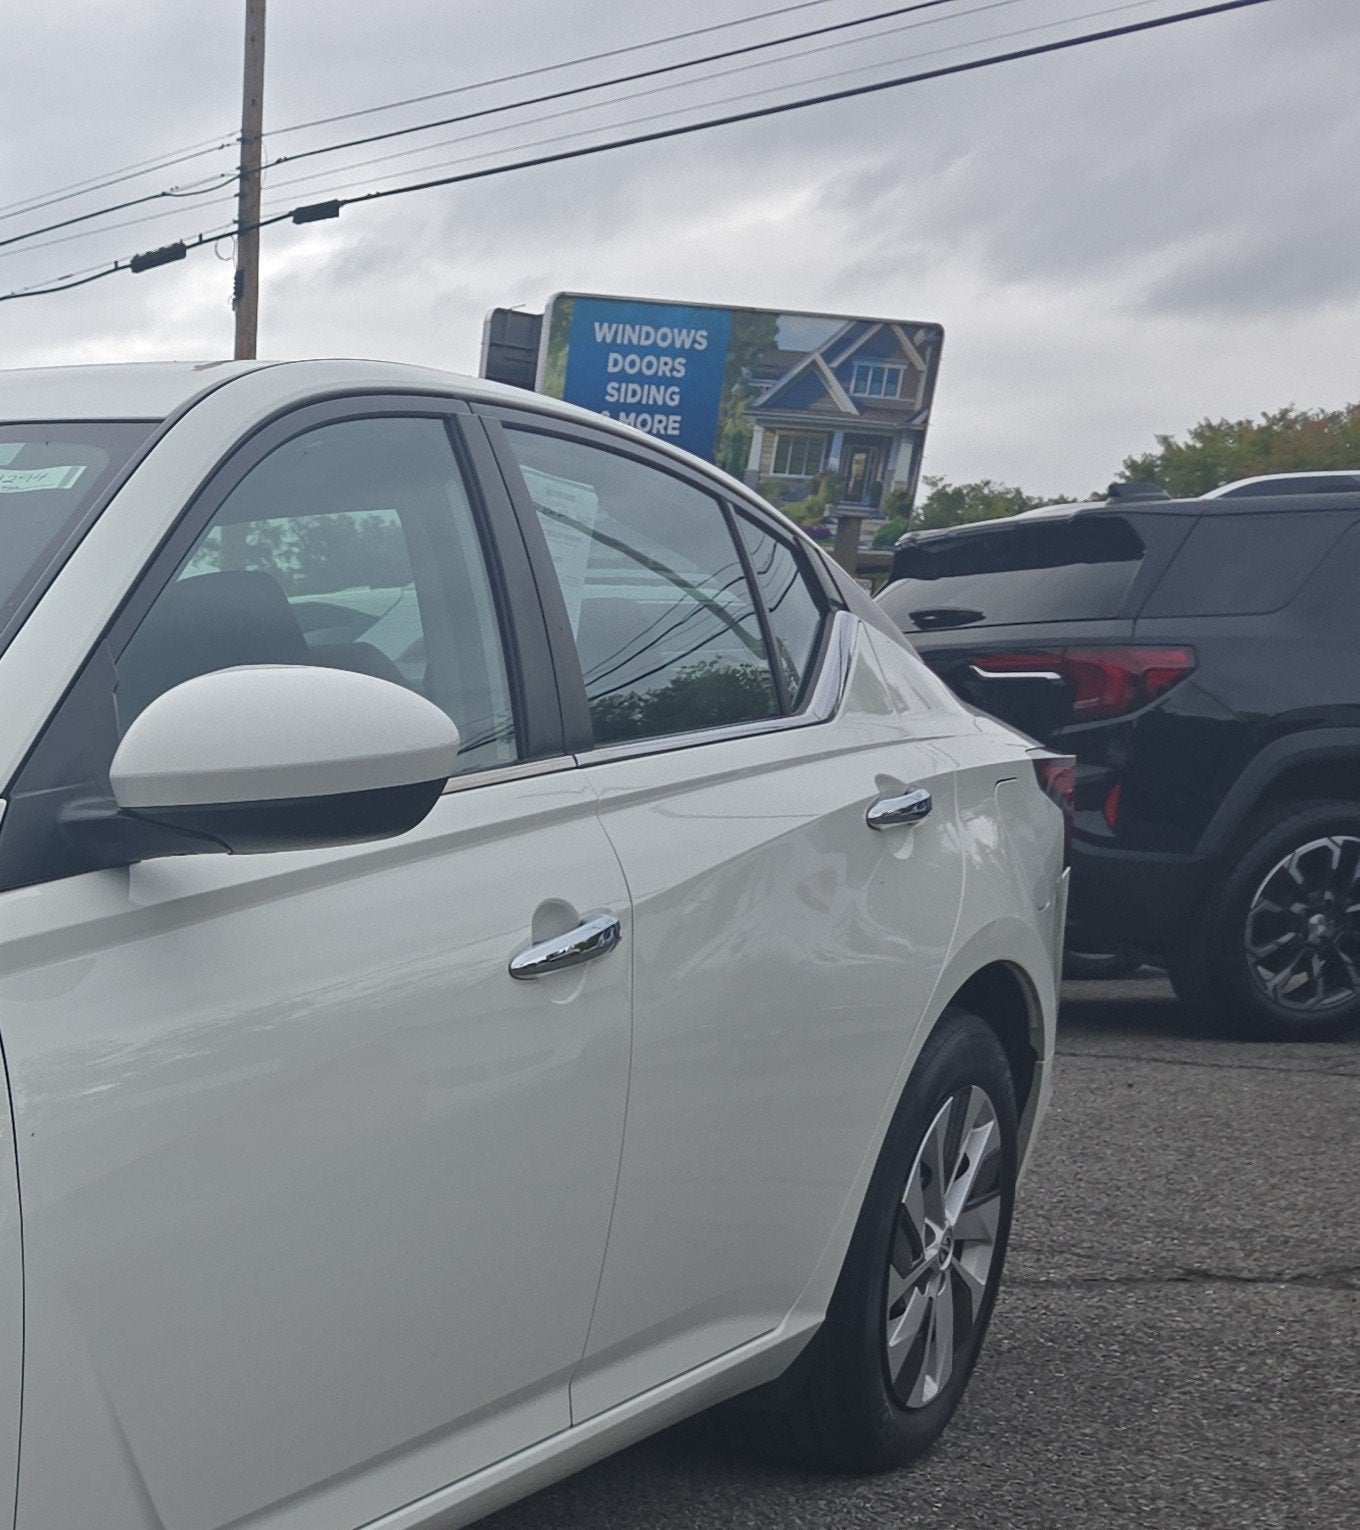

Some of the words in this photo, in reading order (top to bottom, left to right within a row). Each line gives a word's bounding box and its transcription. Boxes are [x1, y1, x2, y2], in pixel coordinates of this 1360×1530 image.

[593, 321, 708, 351] WINDOWS
[606, 352, 686, 379] DOORS
[604, 381, 681, 408] SIDING
[618, 411, 682, 436] MORE
